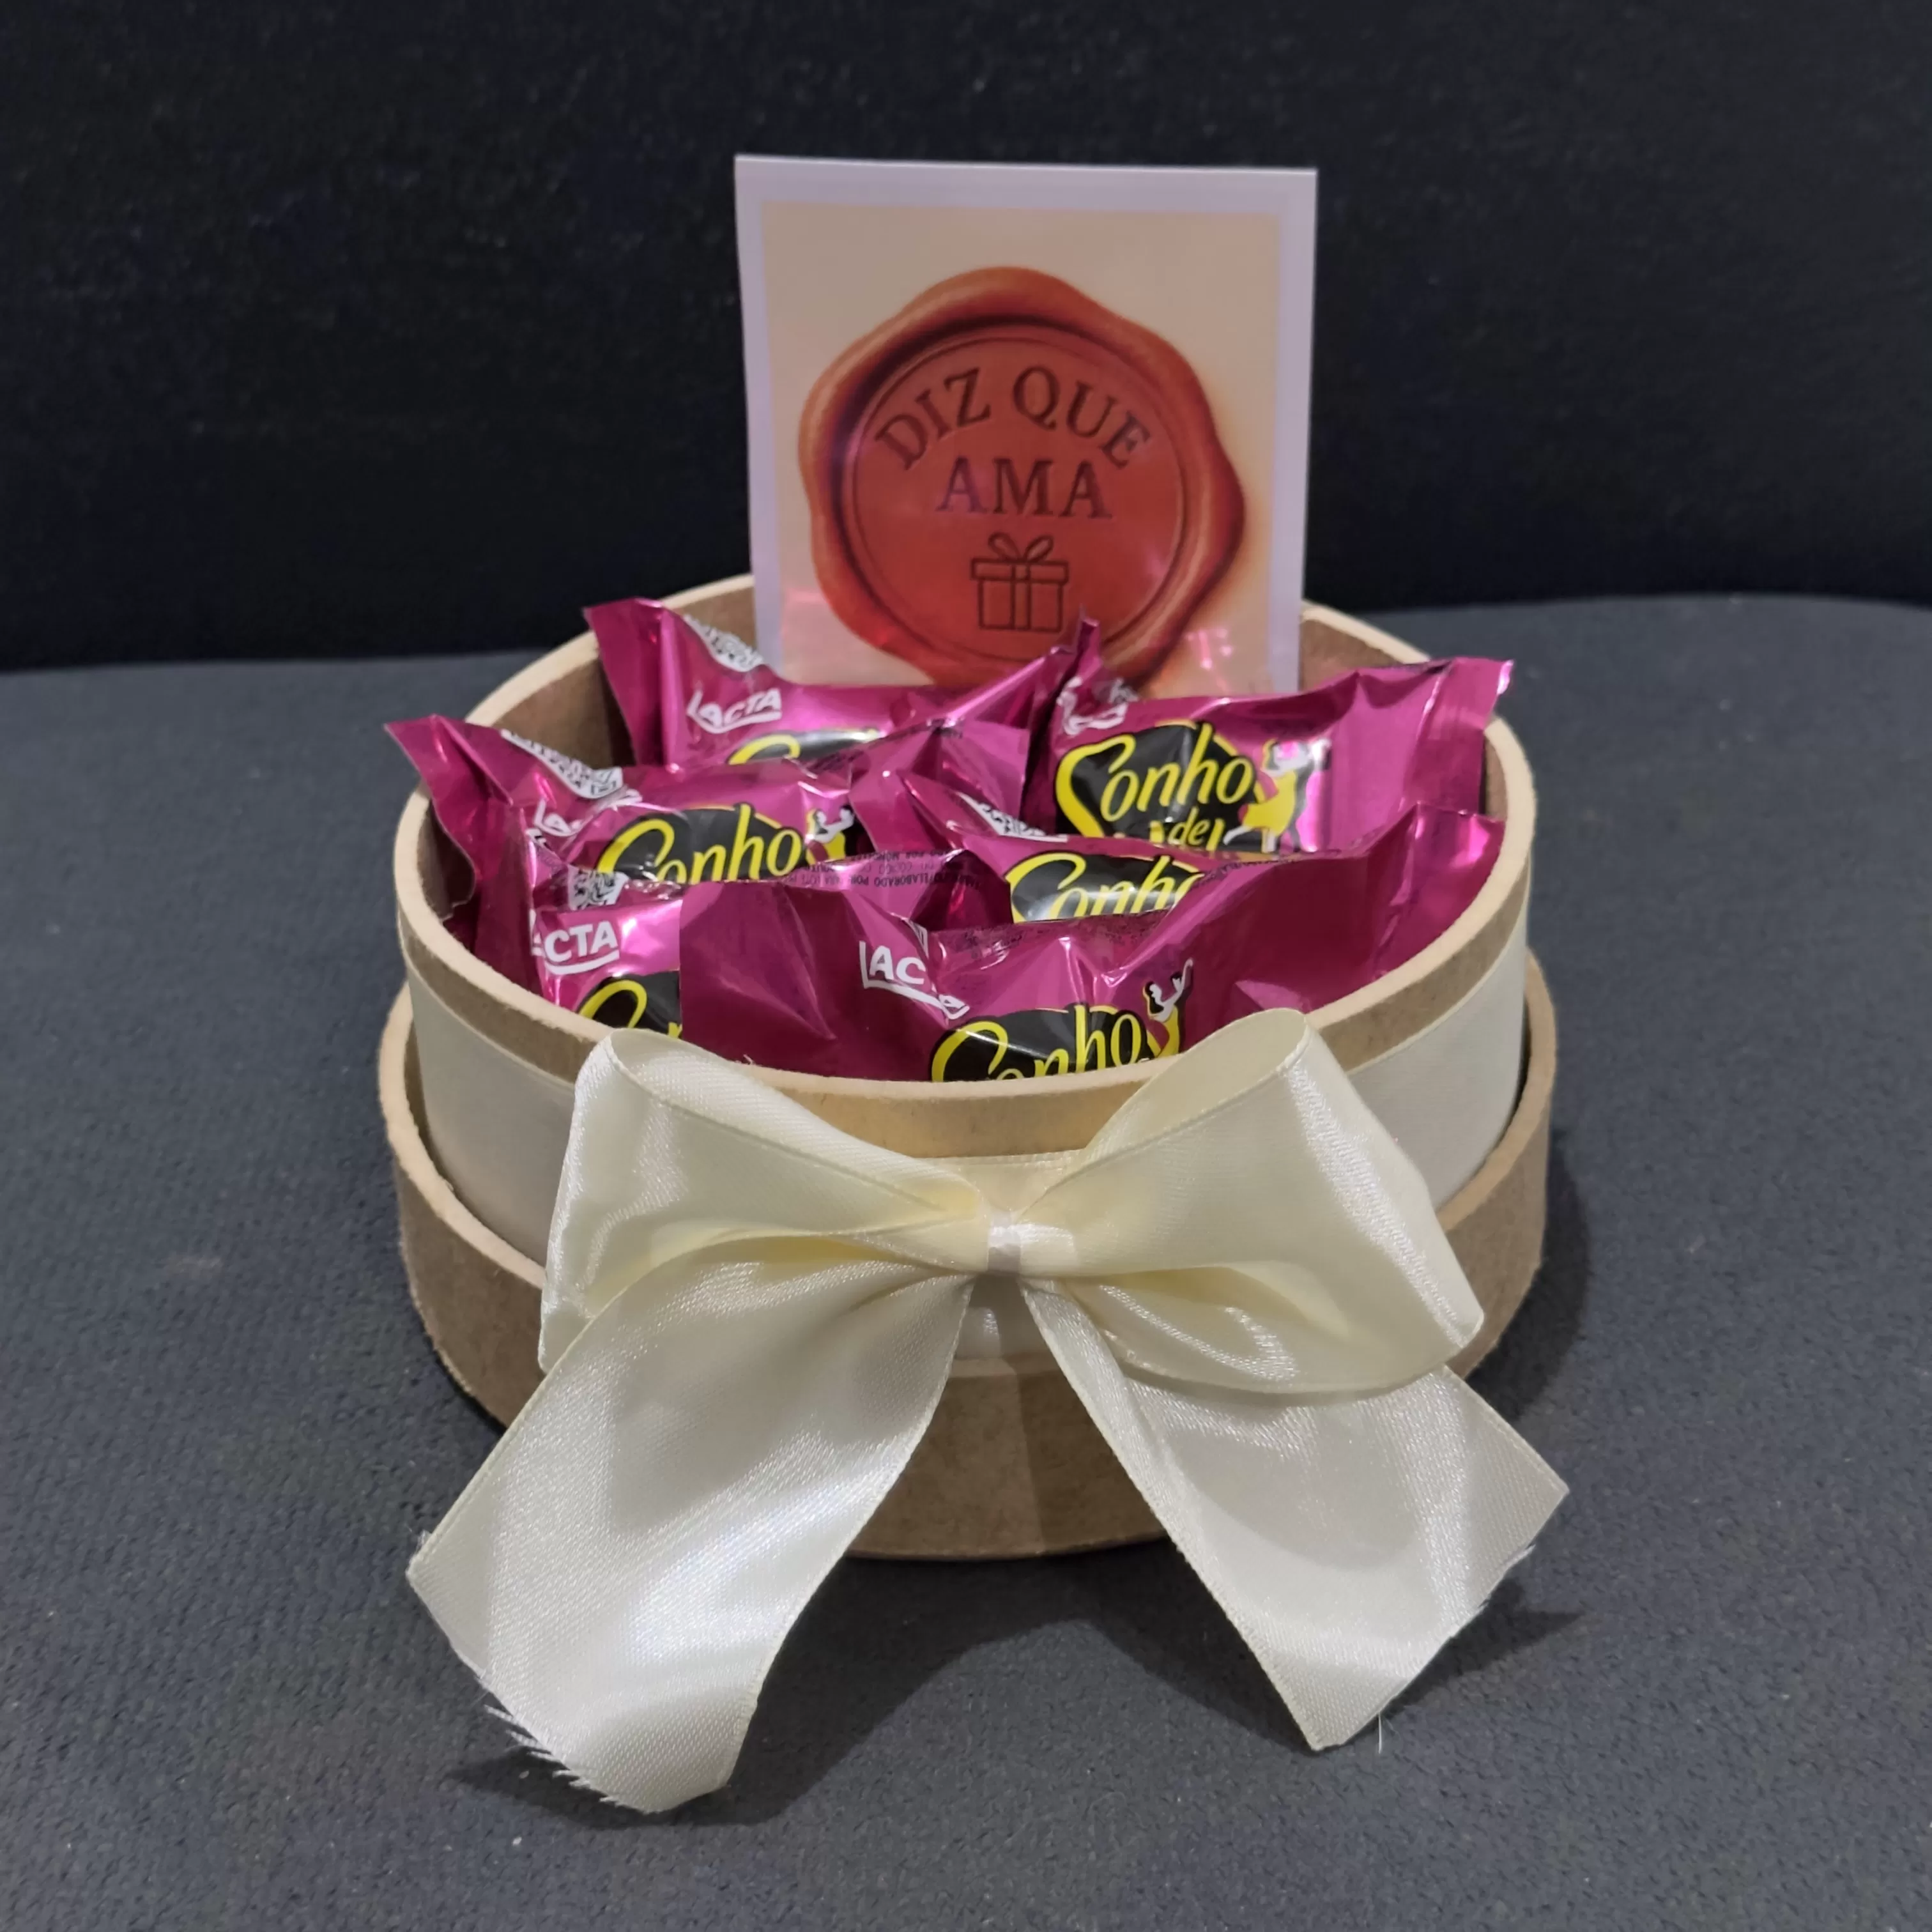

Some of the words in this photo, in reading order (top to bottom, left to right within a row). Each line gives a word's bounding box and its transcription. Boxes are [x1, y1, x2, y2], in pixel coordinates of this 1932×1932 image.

[875, 366, 992, 471] DIZ
[1012, 365, 1152, 469] QUE
[936, 456, 1114, 519] AMA
[687, 687, 782, 733] LACTA
[530, 908, 620, 975] CTA
